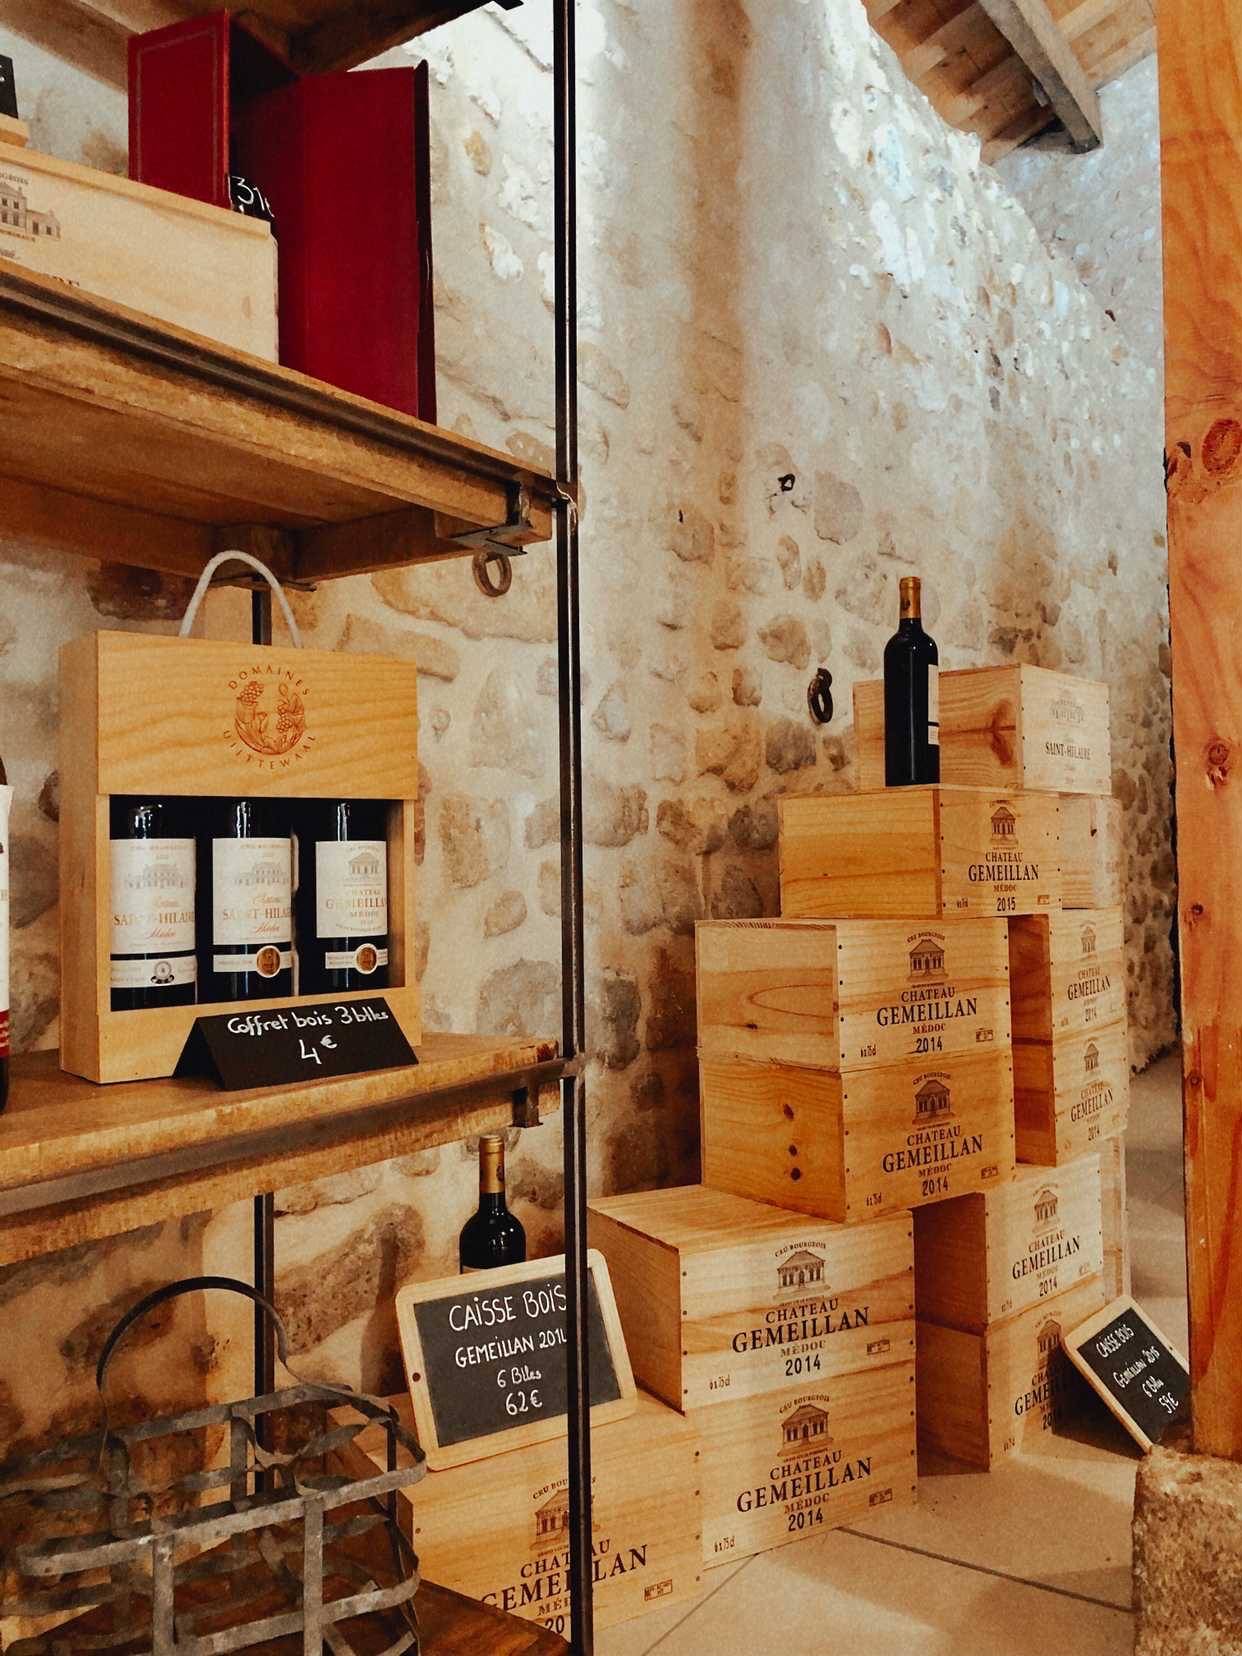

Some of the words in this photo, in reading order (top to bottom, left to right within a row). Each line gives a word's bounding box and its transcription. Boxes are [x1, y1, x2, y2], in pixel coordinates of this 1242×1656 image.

[228, 664, 310, 695] DOMAINES
[968, 864, 1039, 882] GEMEILLAN
[996, 896, 1016, 912] 2015
[901, 986, 956, 1003] CHATEAU
[1067, 975, 1111, 1001] GEMEILLAN
[227, 1014, 289, 1036] Coffret
[291, 1010, 333, 1028] bois
[334, 1006, 353, 1024] 3
[876, 997, 978, 1027] GEMEILLAN
[915, 1035, 943, 1054] 2014
[1071, 1088, 1113, 1122] GEMEILLAN
[906, 1124, 961, 1147] CHATEAU
[882, 1133, 983, 1174] GEMEILLAN
[922, 1175, 949, 1197] 2014
[1012, 1235, 1080, 1280] GEMEILLAN
[1039, 1277, 1058, 1297] 2014
[449, 1296, 516, 1331] CAISSE
[522, 1284, 567, 1318] BOIS
[765, 1297, 840, 1324] CHATEAU
[732, 1306, 870, 1354] GEMEILLAN
[455, 1336, 534, 1368] GEMEILLAN
[785, 1353, 822, 1377] 2014
[497, 1369, 507, 1388] 6
[505, 1389, 543, 1415] 62€
[1158, 1392, 1179, 1414] 59€
[770, 1450, 842, 1480] CHATEAU
[532, 1485, 550, 1500] CRU
[736, 1457, 873, 1513] GEMEILLAN
[788, 1508, 824, 1532] 2014
[480, 1544, 648, 1611] GEMEILAN
[545, 1614, 566, 1634] 20
